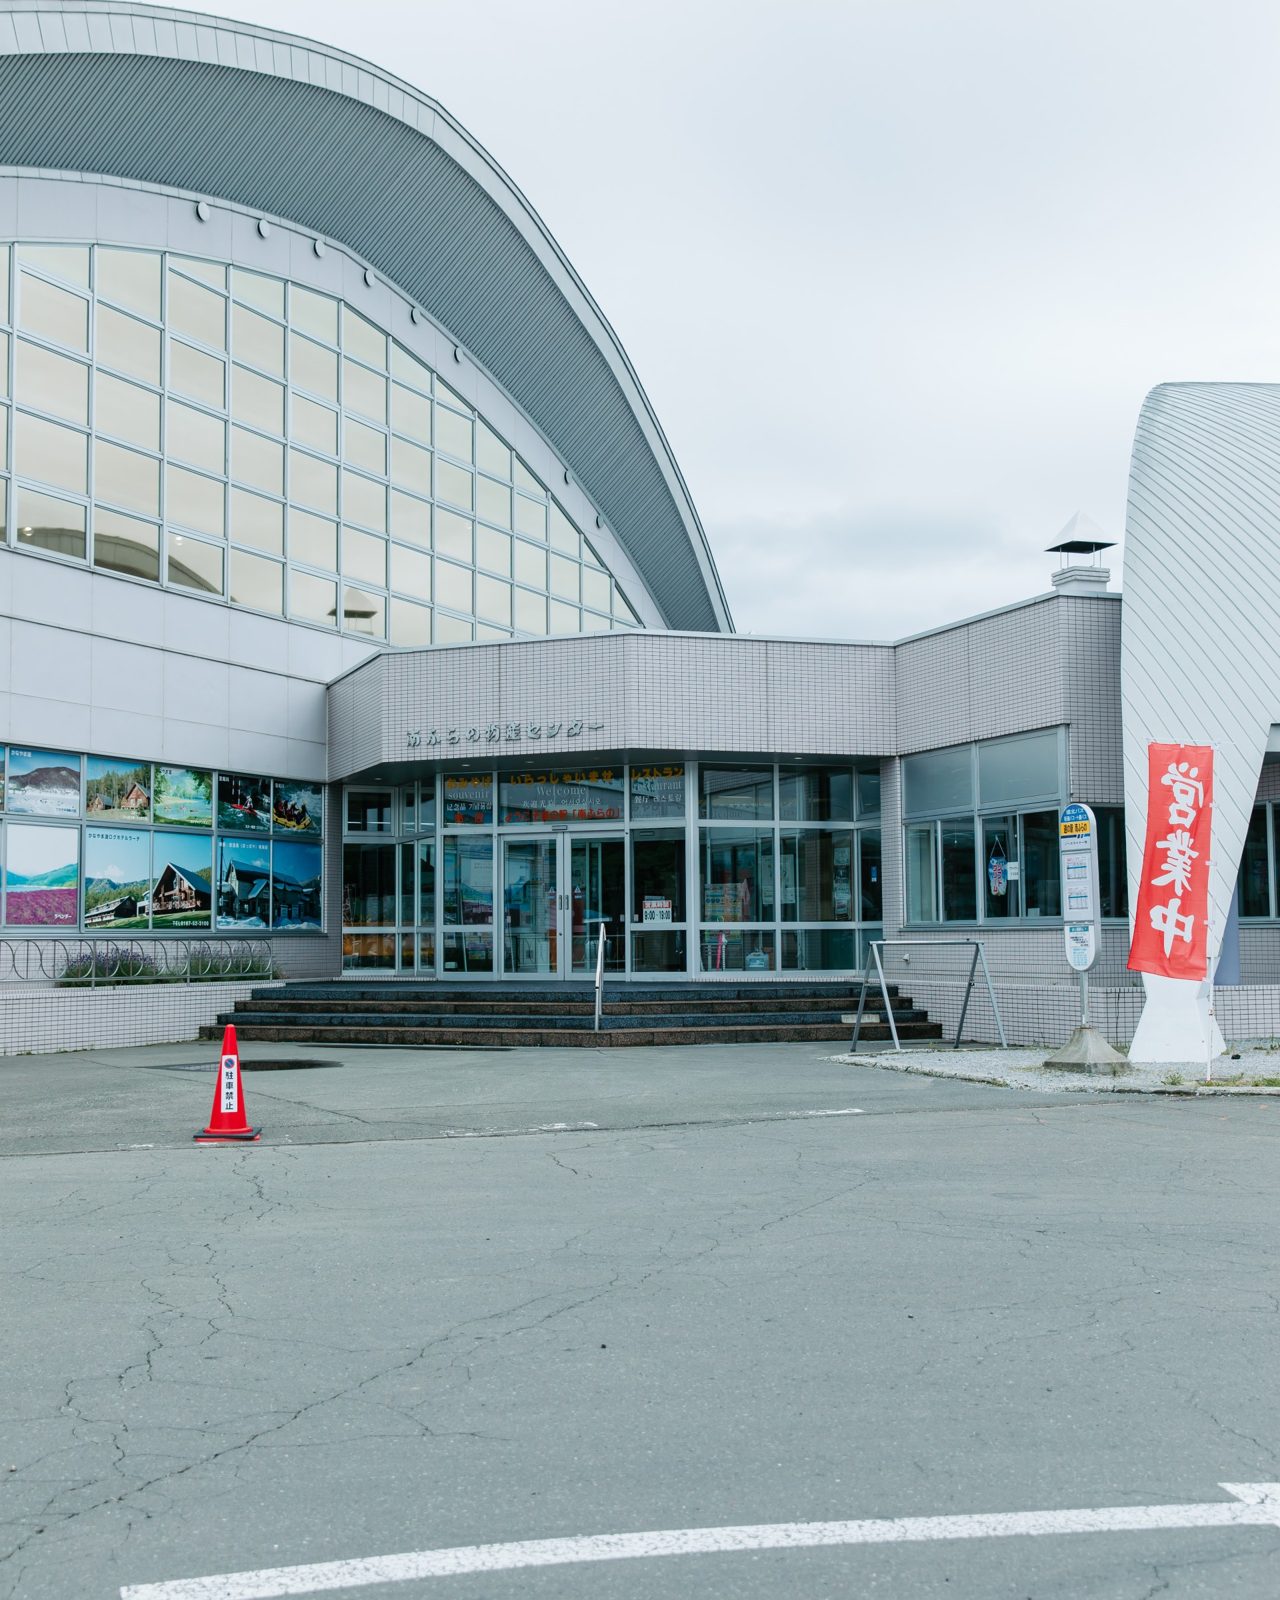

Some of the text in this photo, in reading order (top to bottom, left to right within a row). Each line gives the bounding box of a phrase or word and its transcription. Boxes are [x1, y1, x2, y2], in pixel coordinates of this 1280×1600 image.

[407, 720, 604, 746] 南ふらの物産センター
[511, 769, 613, 786] いらっしゃいませ
[632, 767, 683, 780] レストラン
[448, 790, 489, 800] souvenir
[537, 785, 586, 797] Welcome
[1150, 761, 1204, 959] 営業中
[225, 1071, 234, 1110] 駐車禁止
